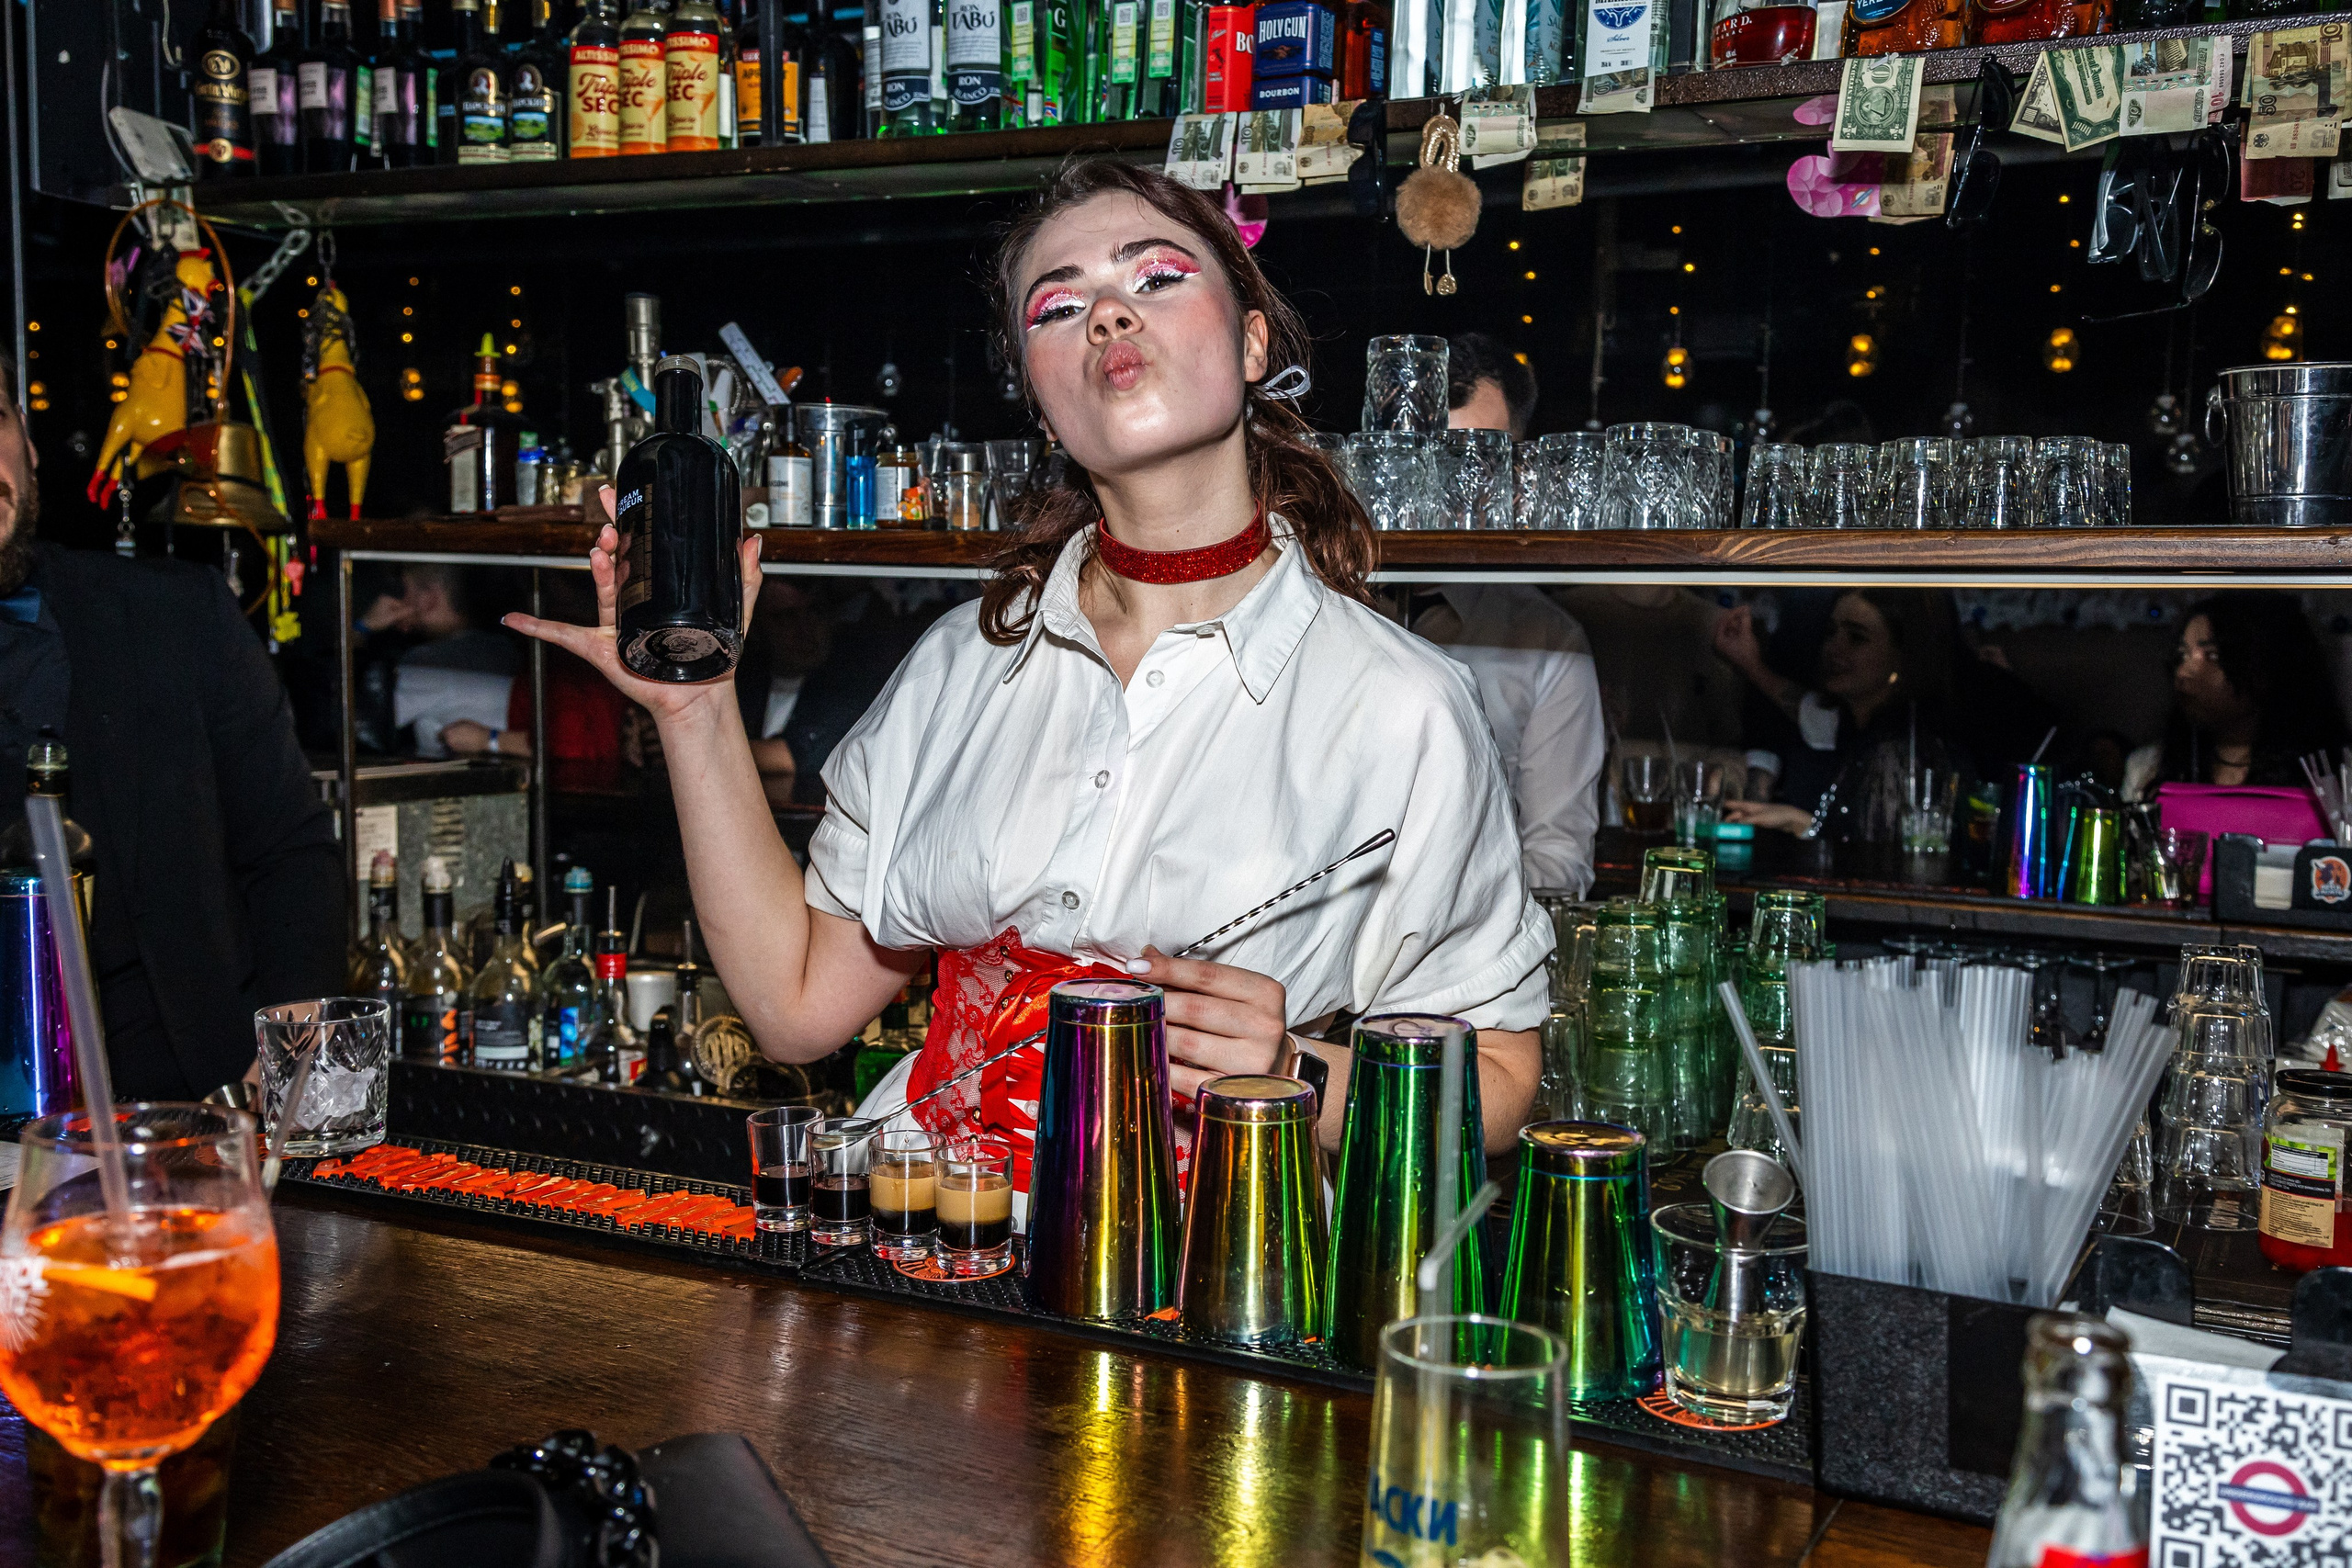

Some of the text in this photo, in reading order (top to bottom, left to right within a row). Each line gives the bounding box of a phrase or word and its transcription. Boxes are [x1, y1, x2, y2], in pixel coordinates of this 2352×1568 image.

[1258, 17, 1284, 44] HOLY
[1286, 16, 1307, 39] GUN
[958, 76, 981, 86] RON
[1260, 87, 1300, 98] BOURBON
[2210, 91, 2225, 107] 10
[2258, 95, 2277, 117] 50
[1241, 126, 1254, 145] 10
[1171, 137, 1186, 154] 10
[617, 489, 640, 511] CREAM
